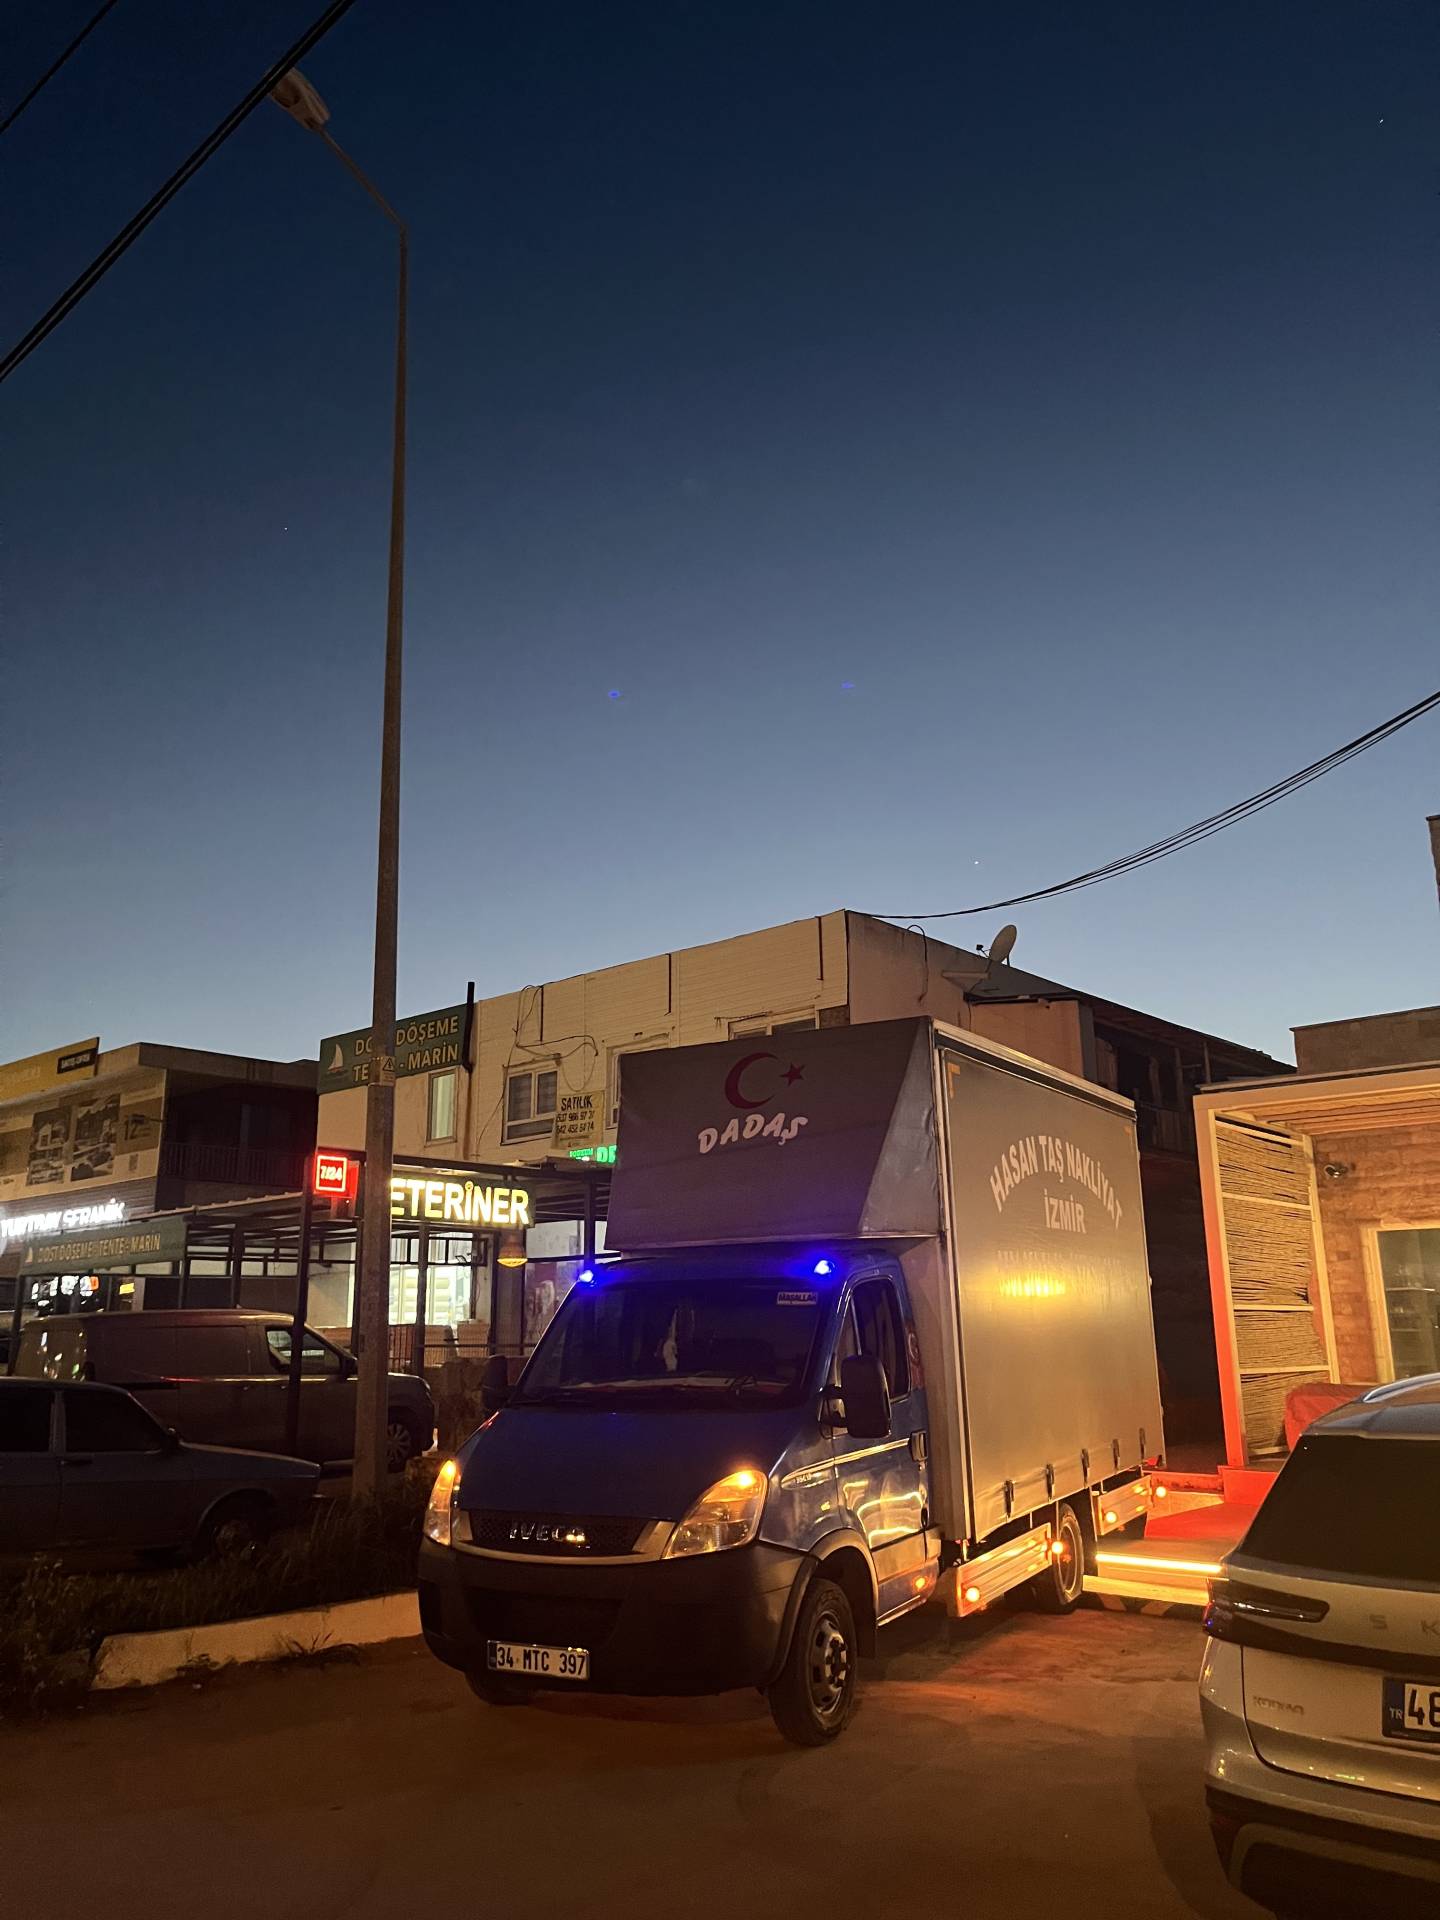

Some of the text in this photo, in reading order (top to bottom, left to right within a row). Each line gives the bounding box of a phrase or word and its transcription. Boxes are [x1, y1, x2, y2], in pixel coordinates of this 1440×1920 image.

[355, 1015, 459, 1056] DO DÖŞEME
[408, 1042, 459, 1071] MARİN
[698, 1112, 808, 1154] DADAŞ
[320, 1165, 343, 1181] 7/24
[990, 1135, 1122, 1229] HASAN TAŞ NAKLİYAT
[391, 1178, 529, 1224] ETERİNER
[1044, 1188, 1087, 1234] İZMİR
[509, 1523, 586, 1542] IVECO
[498, 1646, 586, 1675] 34 MTC 397
